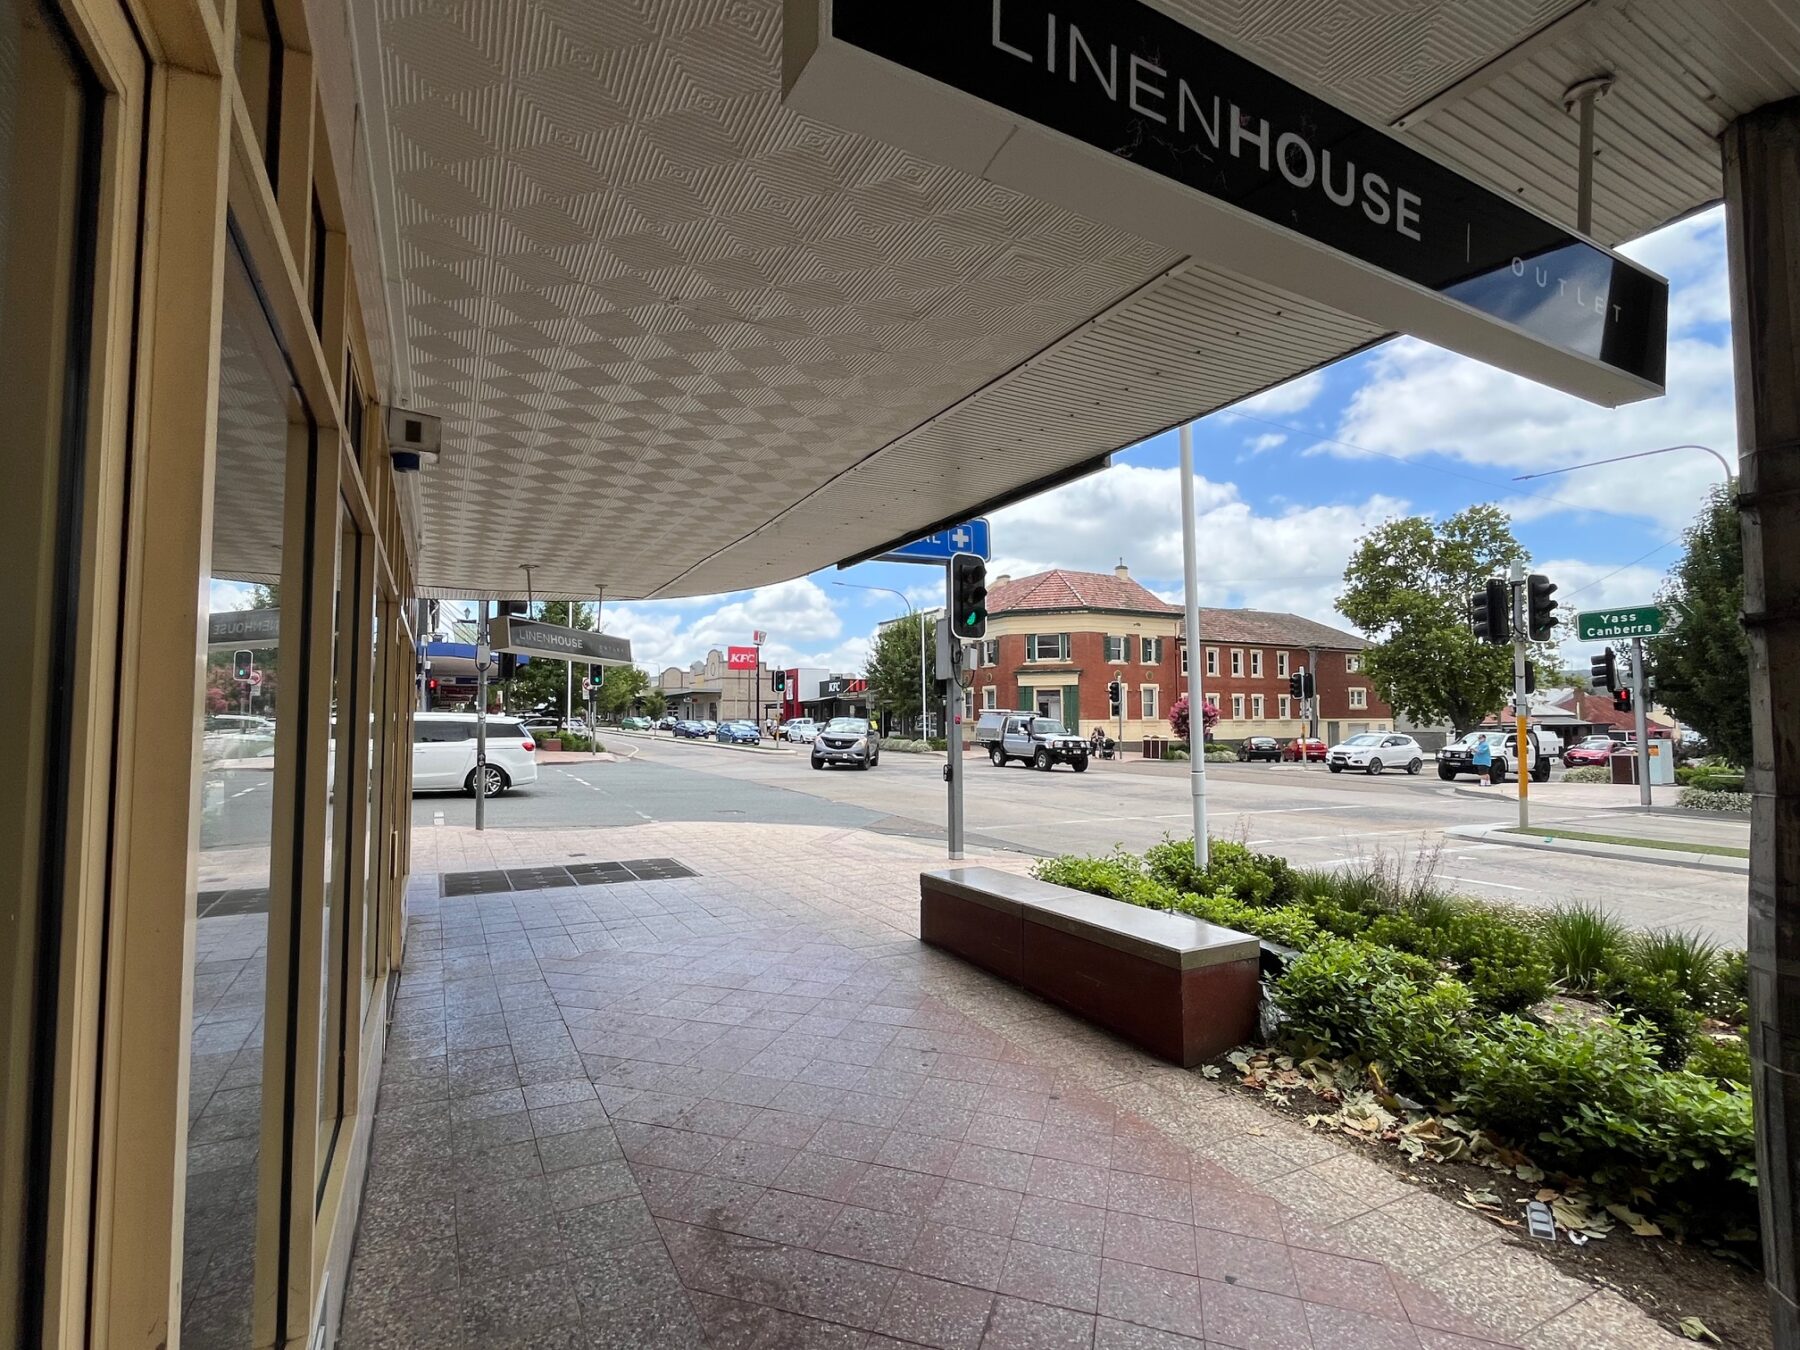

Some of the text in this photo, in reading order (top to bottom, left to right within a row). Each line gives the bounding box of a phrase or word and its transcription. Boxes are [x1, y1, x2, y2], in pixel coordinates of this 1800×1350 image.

[992, 0, 1622, 323] LINENHOUSE OUTLET
[1600, 613, 1637, 624] Yass
[1586, 624, 1652, 637] Canberra
[519, 629, 584, 649] LINENHOUSE
[729, 653, 755, 663] KFC
[828, 681, 840, 692] KFC
